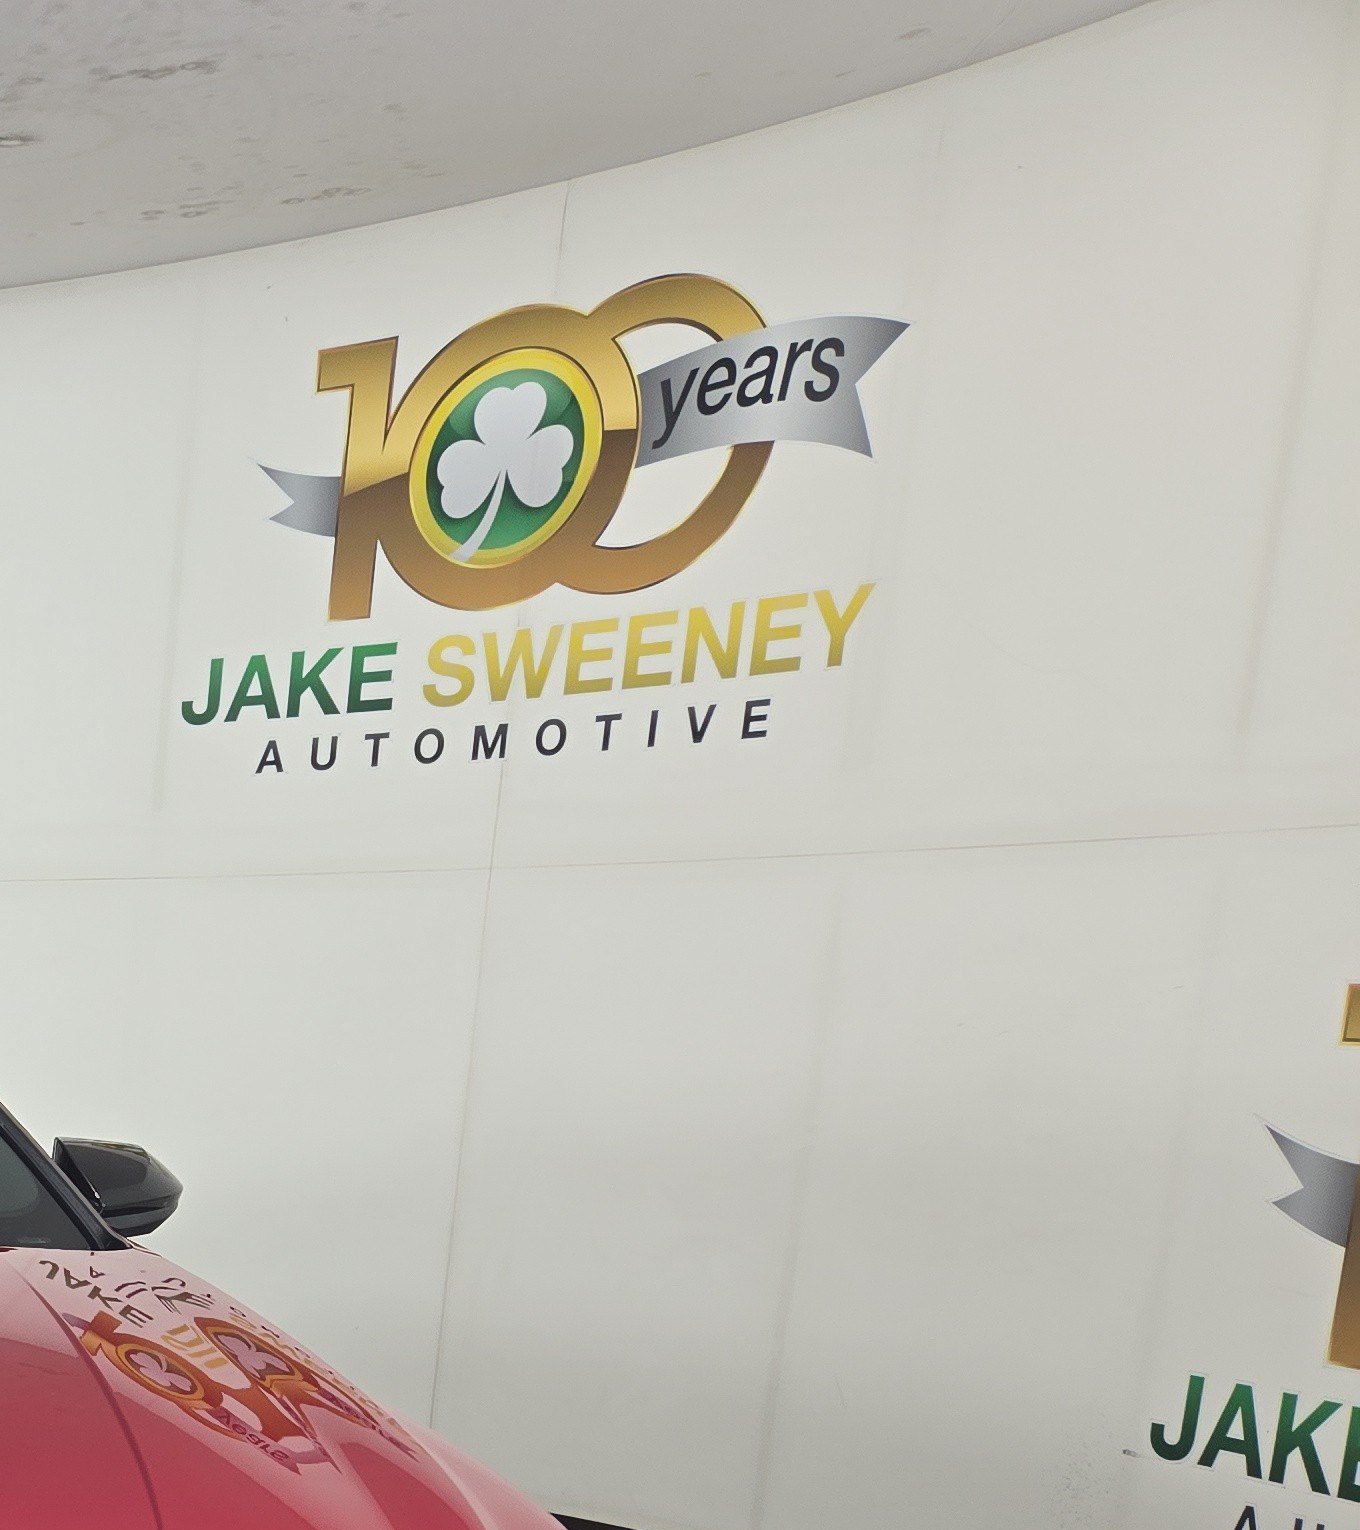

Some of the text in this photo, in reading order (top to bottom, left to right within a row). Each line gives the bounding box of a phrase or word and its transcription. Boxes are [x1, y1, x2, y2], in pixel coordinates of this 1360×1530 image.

[317, 273, 845, 622] 100 years
[181, 583, 876, 726] JAKE SWEENEY
[256, 699, 771, 774] AUTOMOTIVE
